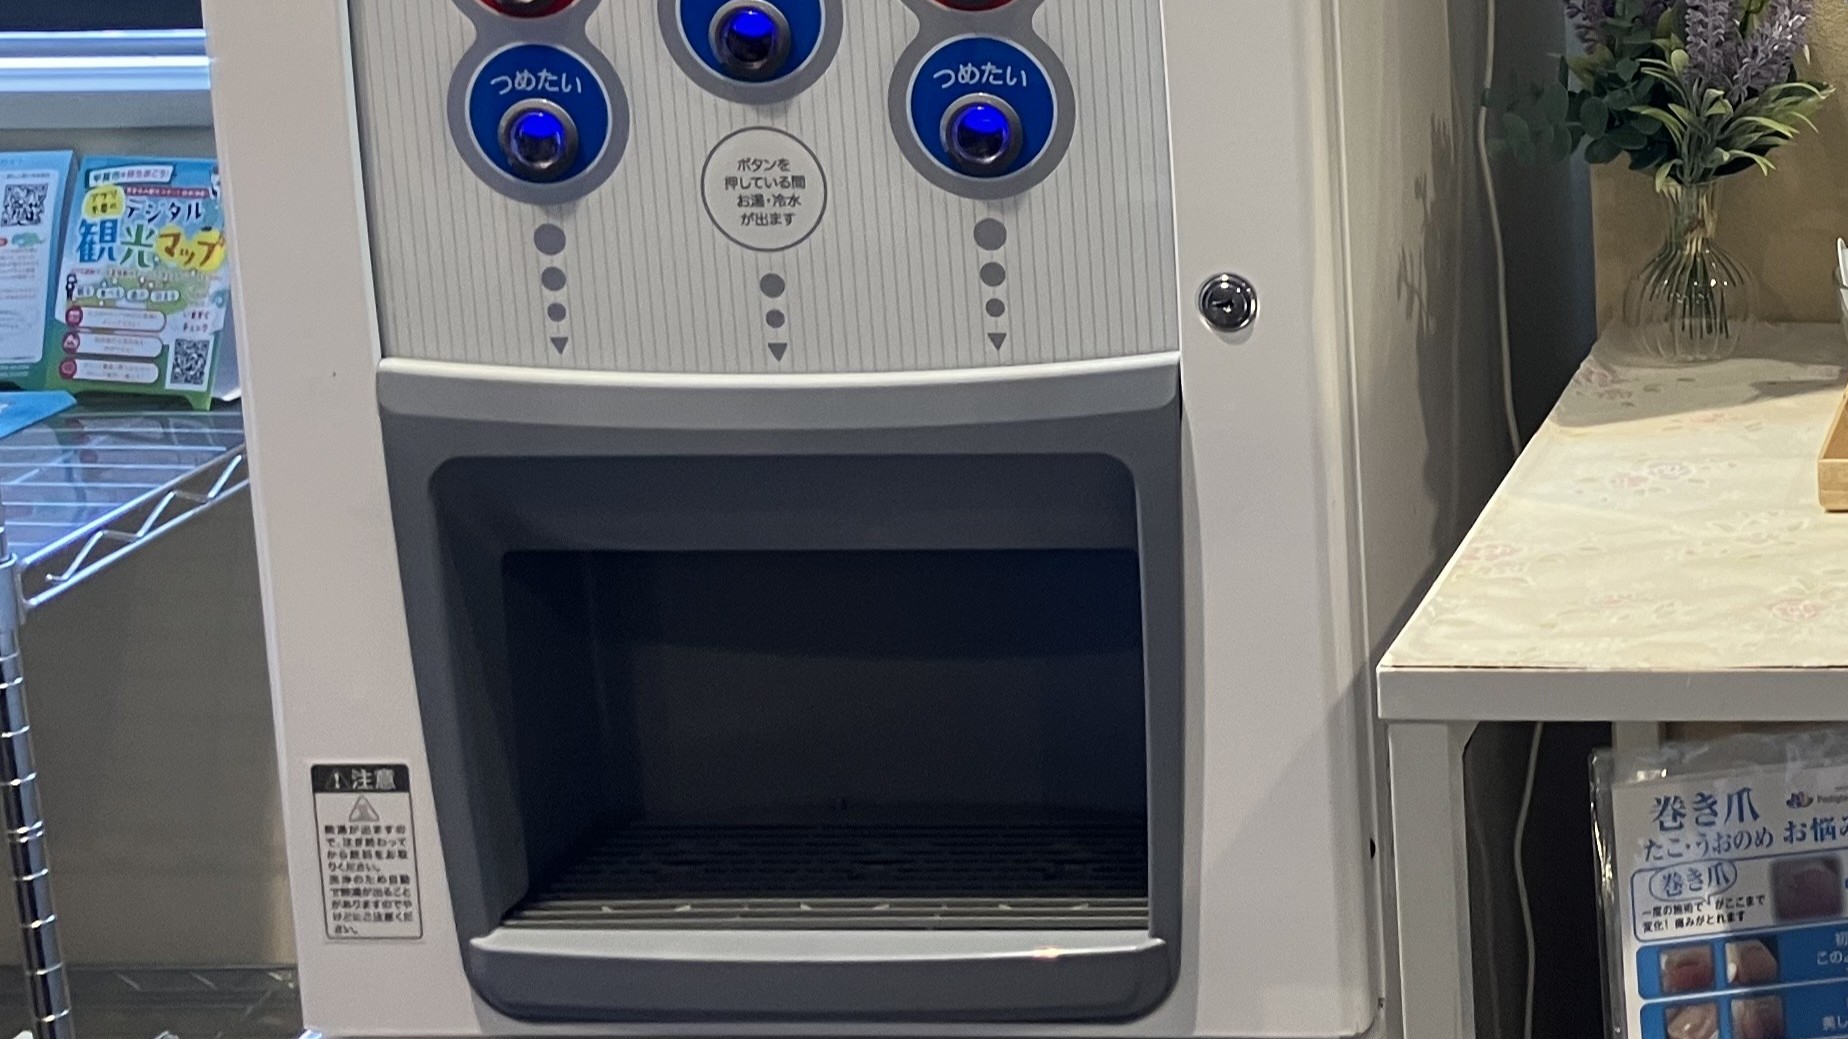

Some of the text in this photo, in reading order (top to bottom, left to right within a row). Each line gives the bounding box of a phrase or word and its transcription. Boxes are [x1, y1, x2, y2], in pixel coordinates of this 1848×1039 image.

[490, 68, 582, 95] つめたい
[933, 62, 1028, 89] つめたい
[737, 157, 791, 172] ボタンを
[724, 175, 806, 190] 押している間
[127, 198, 201, 223] デジタル
[740, 211, 796, 226] が出ます
[76, 219, 225, 268] 観光マップ
[1652, 788, 1760, 832] 巻き爪
[1643, 827, 1774, 861] たこ・うおのめ
[1662, 862, 1730, 898] 巻き爪
